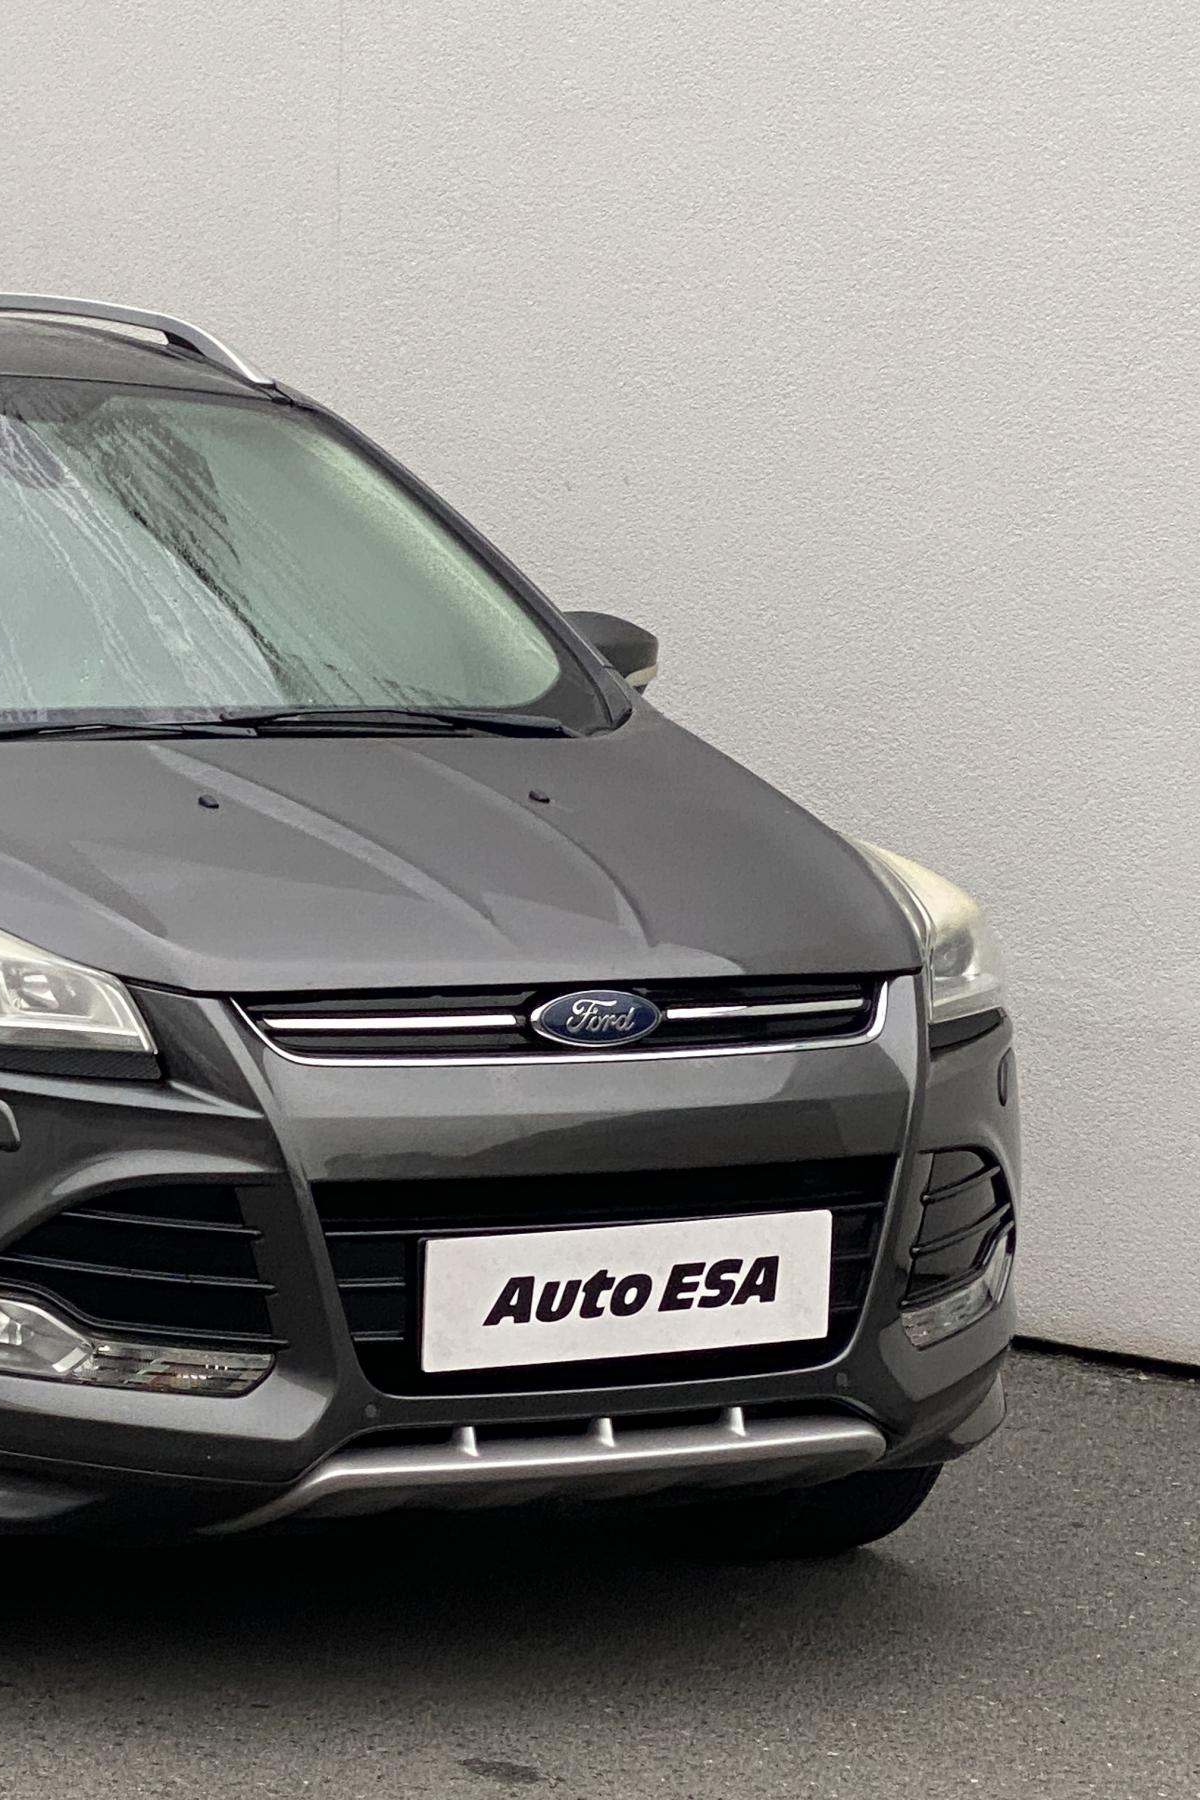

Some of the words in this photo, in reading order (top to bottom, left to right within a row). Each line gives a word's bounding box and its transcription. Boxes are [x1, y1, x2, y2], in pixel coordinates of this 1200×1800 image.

[566, 999, 635, 1034] Ford
[482, 1269, 653, 1327] Auto
[658, 1255, 780, 1313] ESA
